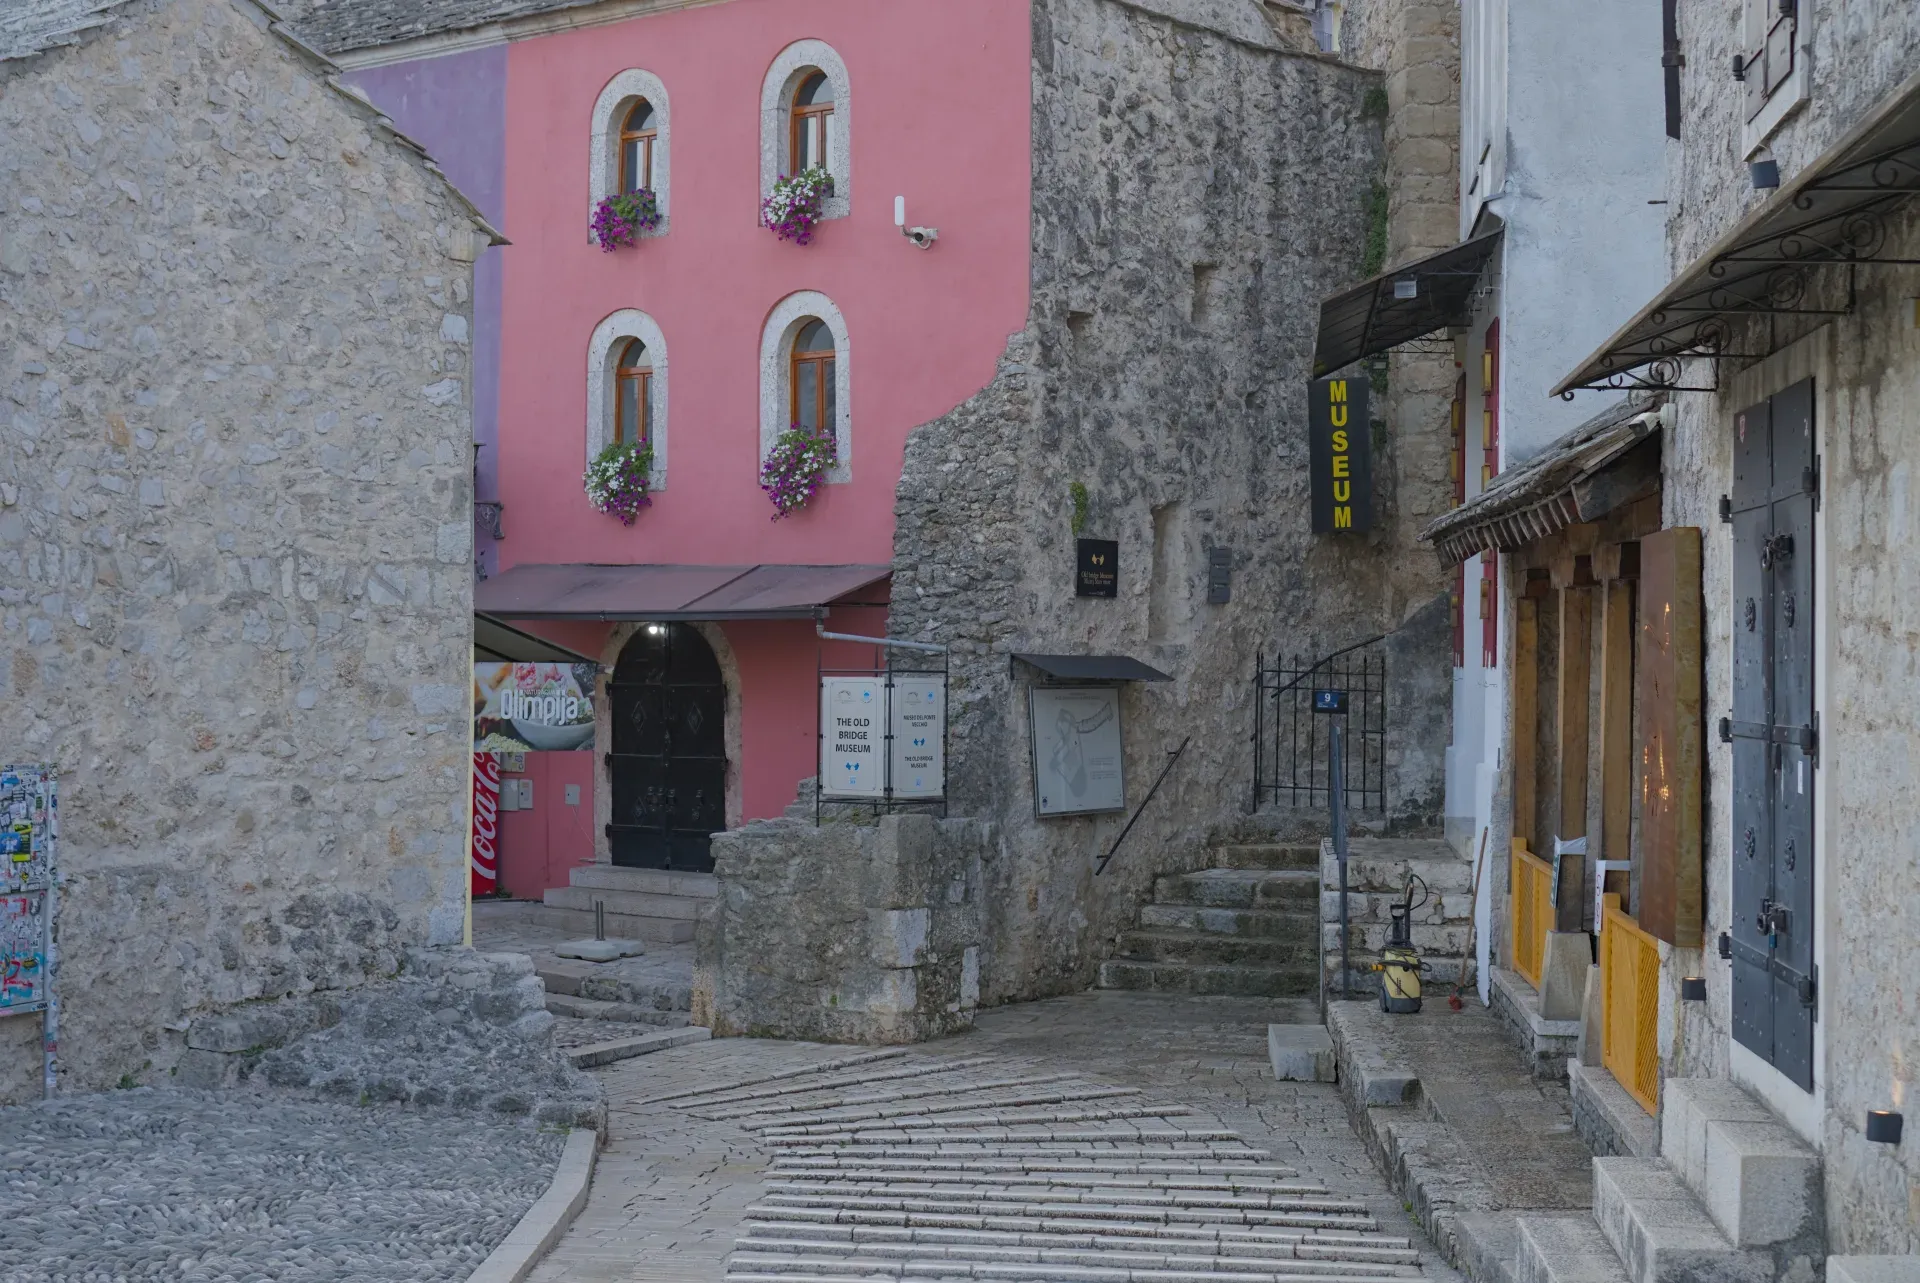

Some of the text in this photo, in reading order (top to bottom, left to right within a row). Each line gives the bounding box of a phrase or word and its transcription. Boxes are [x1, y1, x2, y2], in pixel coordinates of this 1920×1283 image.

[1330, 381, 1351, 528] MUSEUM
[1324, 693, 1331, 702] 9
[500, 688, 578, 726] Olimpija
[836, 718, 870, 726] THE OLD
[838, 731, 868, 740] BRIDGE
[835, 743, 871, 753] MUSEUM
